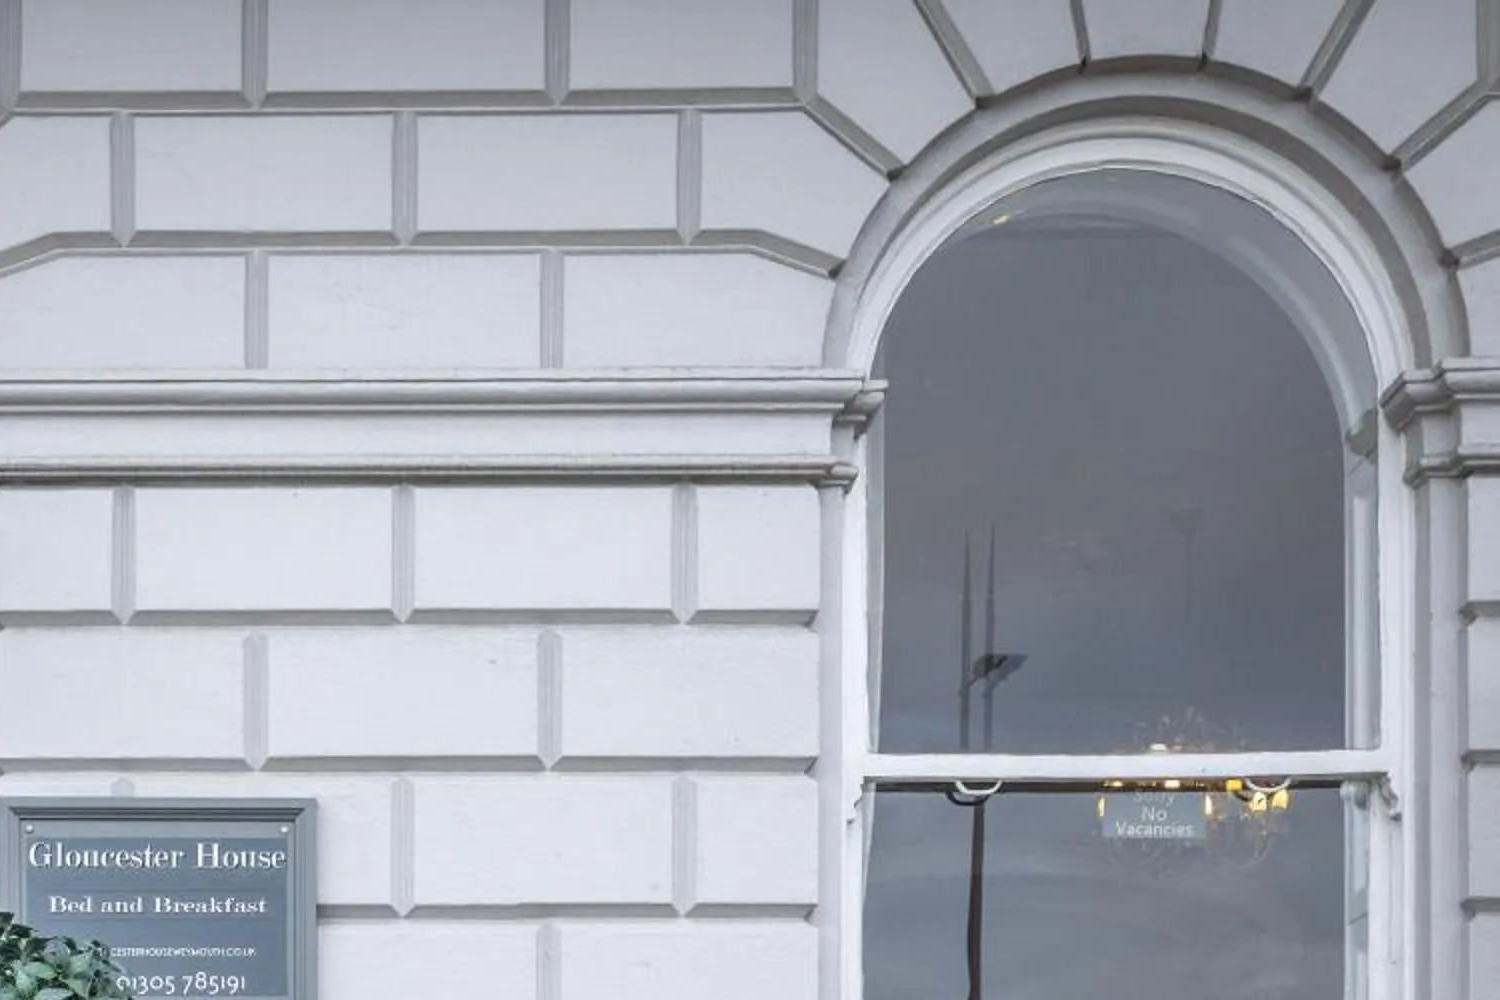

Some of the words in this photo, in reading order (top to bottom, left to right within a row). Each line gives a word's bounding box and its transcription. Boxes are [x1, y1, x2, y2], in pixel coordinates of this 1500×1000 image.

[1141, 806, 1168, 821] No
[1115, 821, 1194, 838] Vacancies
[29, 841, 185, 869] Gloucester
[195, 841, 287, 869] House
[49, 895, 92, 913] Bed
[100, 896, 143, 913] and
[154, 896, 268, 913] Breakfast
[116, 973, 175, 995] 01305
[181, 970, 246, 995] 785191
